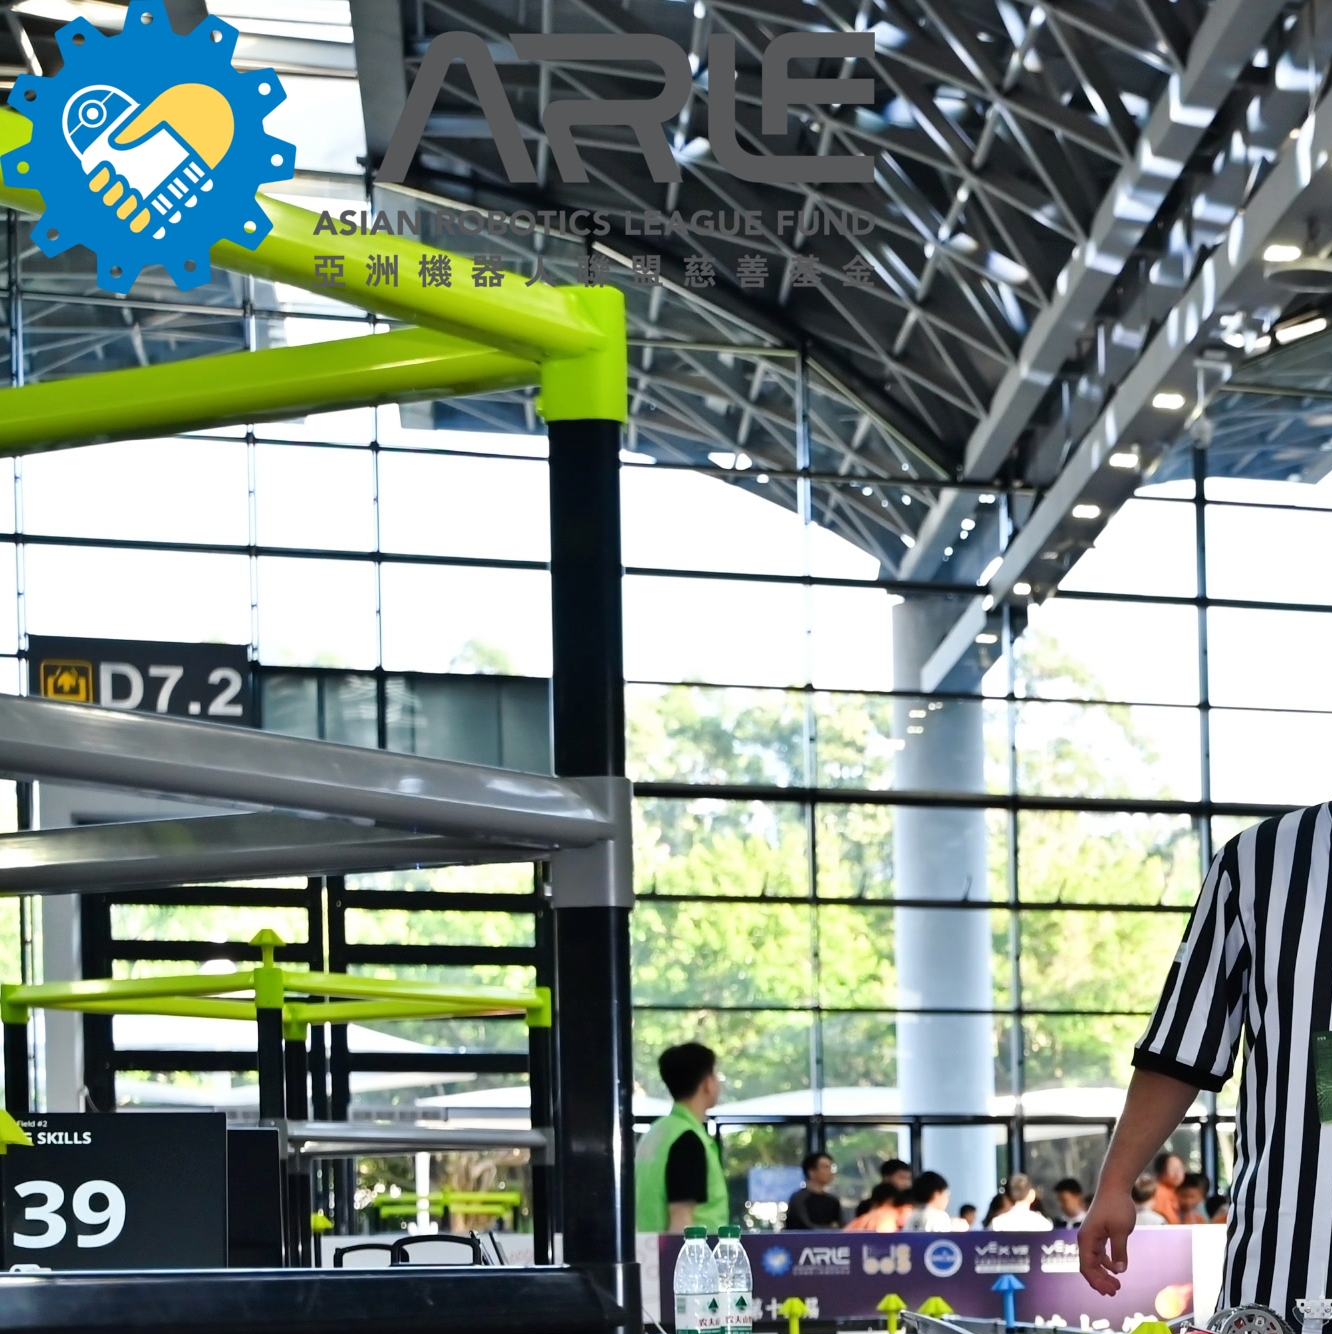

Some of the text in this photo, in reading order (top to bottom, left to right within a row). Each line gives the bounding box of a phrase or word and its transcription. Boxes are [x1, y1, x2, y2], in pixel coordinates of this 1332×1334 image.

[99, 661, 244, 717] D7.2
[37, 1120, 48, 1128] #2
[37, 1131, 92, 1145] SKILLS
[13, 1179, 127, 1249] 39
